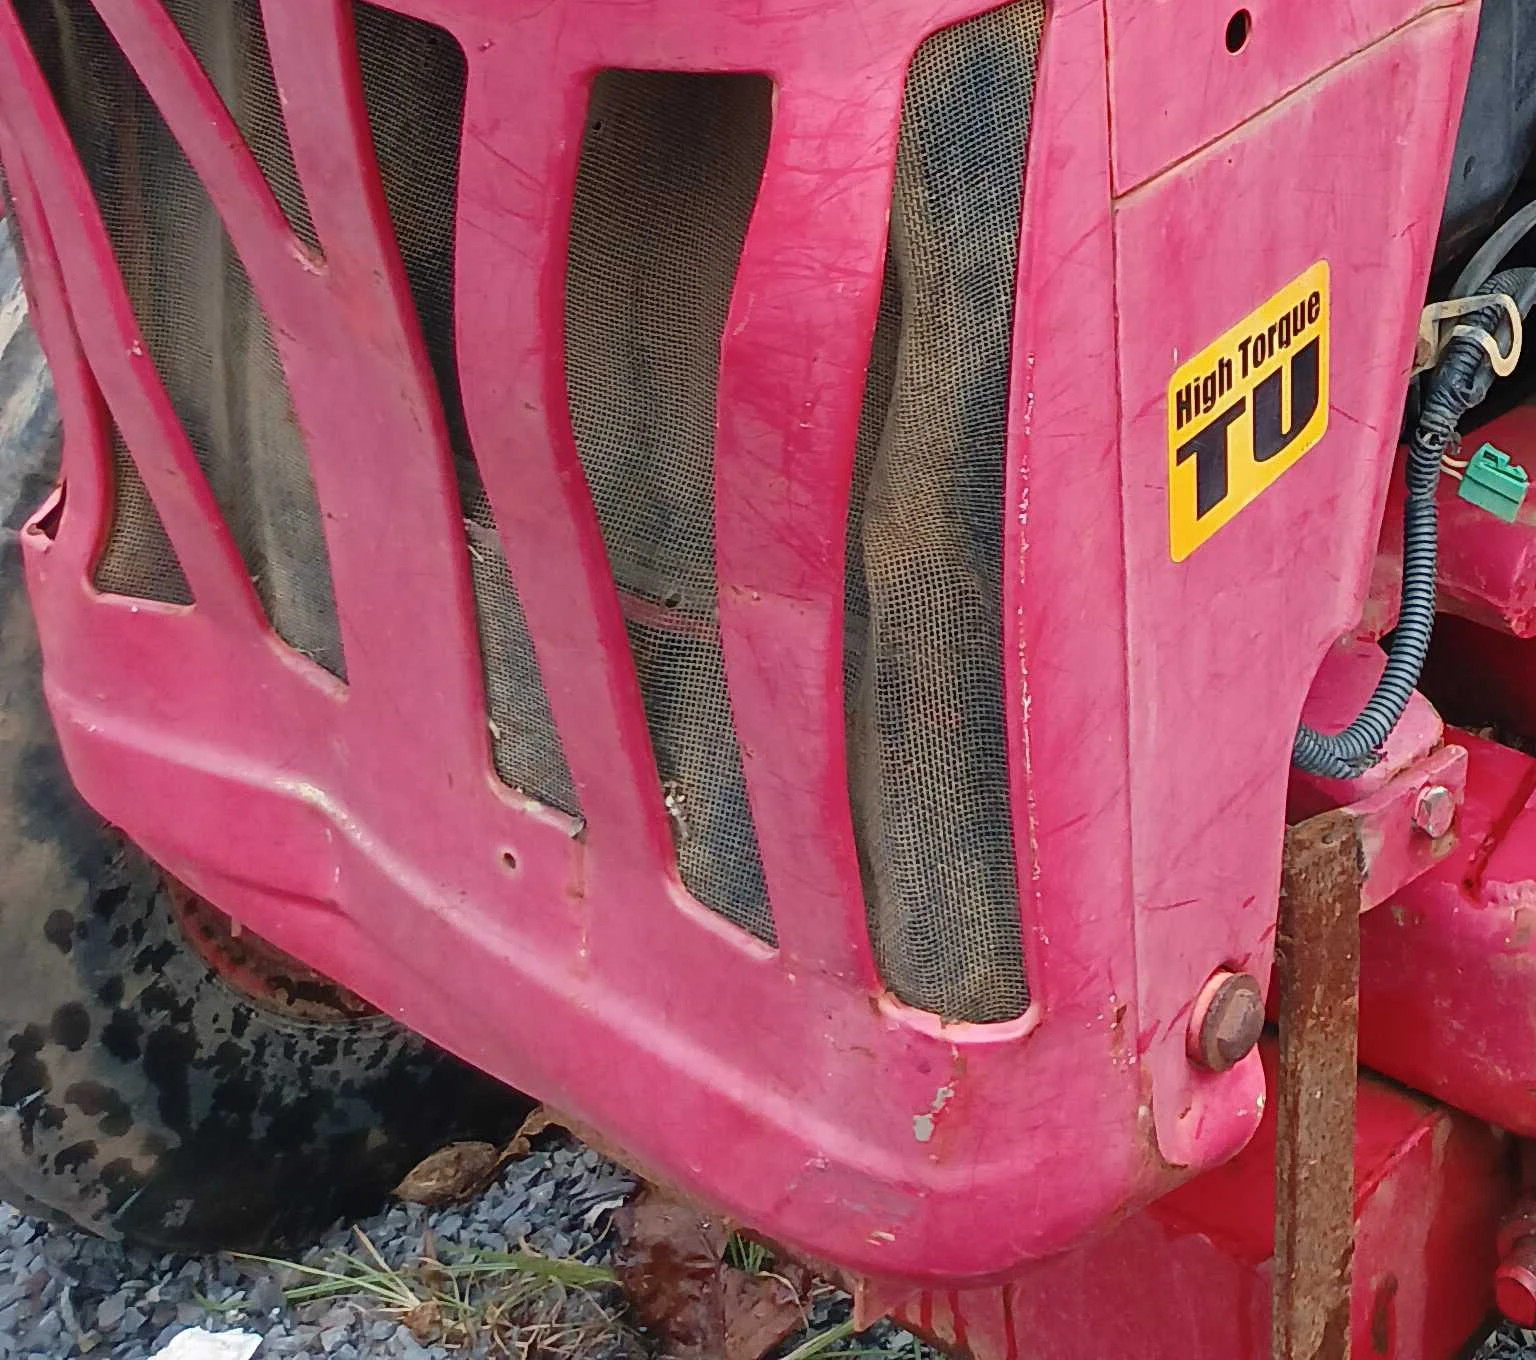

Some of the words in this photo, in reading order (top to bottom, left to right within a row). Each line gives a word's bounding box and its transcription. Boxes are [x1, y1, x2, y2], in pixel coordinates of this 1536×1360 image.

[1175, 356, 1233, 431] High
[1238, 290, 1321, 379] Torque
[1175, 335, 1321, 521] TU
